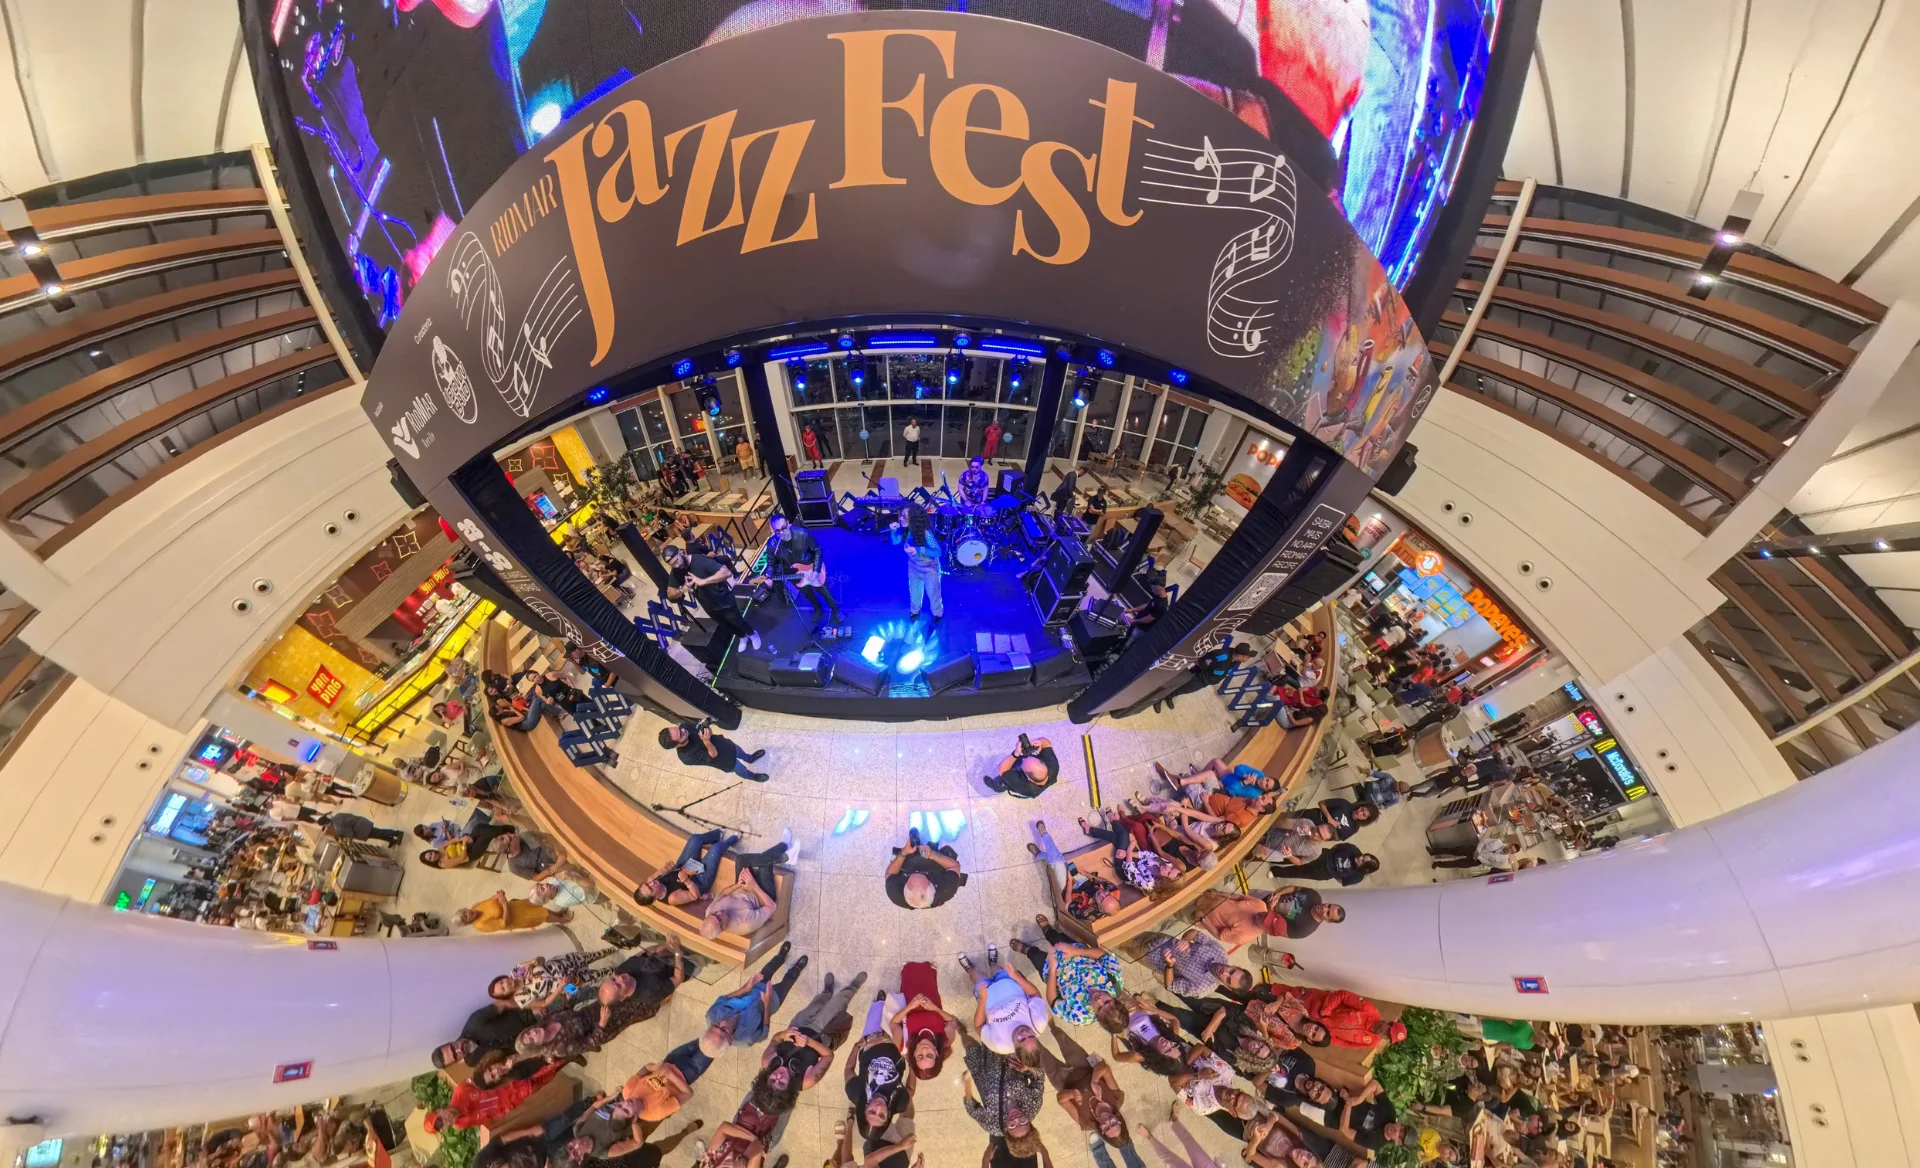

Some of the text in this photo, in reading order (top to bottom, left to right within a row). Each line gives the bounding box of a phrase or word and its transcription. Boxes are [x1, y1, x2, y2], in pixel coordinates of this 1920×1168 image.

[544, 28, 1156, 367] Jazz Fest
[490, 174, 559, 257] RIOMAR
[1303, 529, 1323, 541] MAIS
[1311, 516, 1333, 530] SAIBA
[457, 518, 485, 543] 28
[484, 551, 513, 571] 30
[1279, 549, 1308, 562] RIOMAR
[1271, 560, 1298, 571] RECIFE
[420, 565, 450, 594] YAN PING
[311, 672, 330, 694] YAN
[320, 678, 342, 704] PING
[1605, 751, 1635, 786] McDonald's
[992, 1011, 1016, 1024] MOMENT
